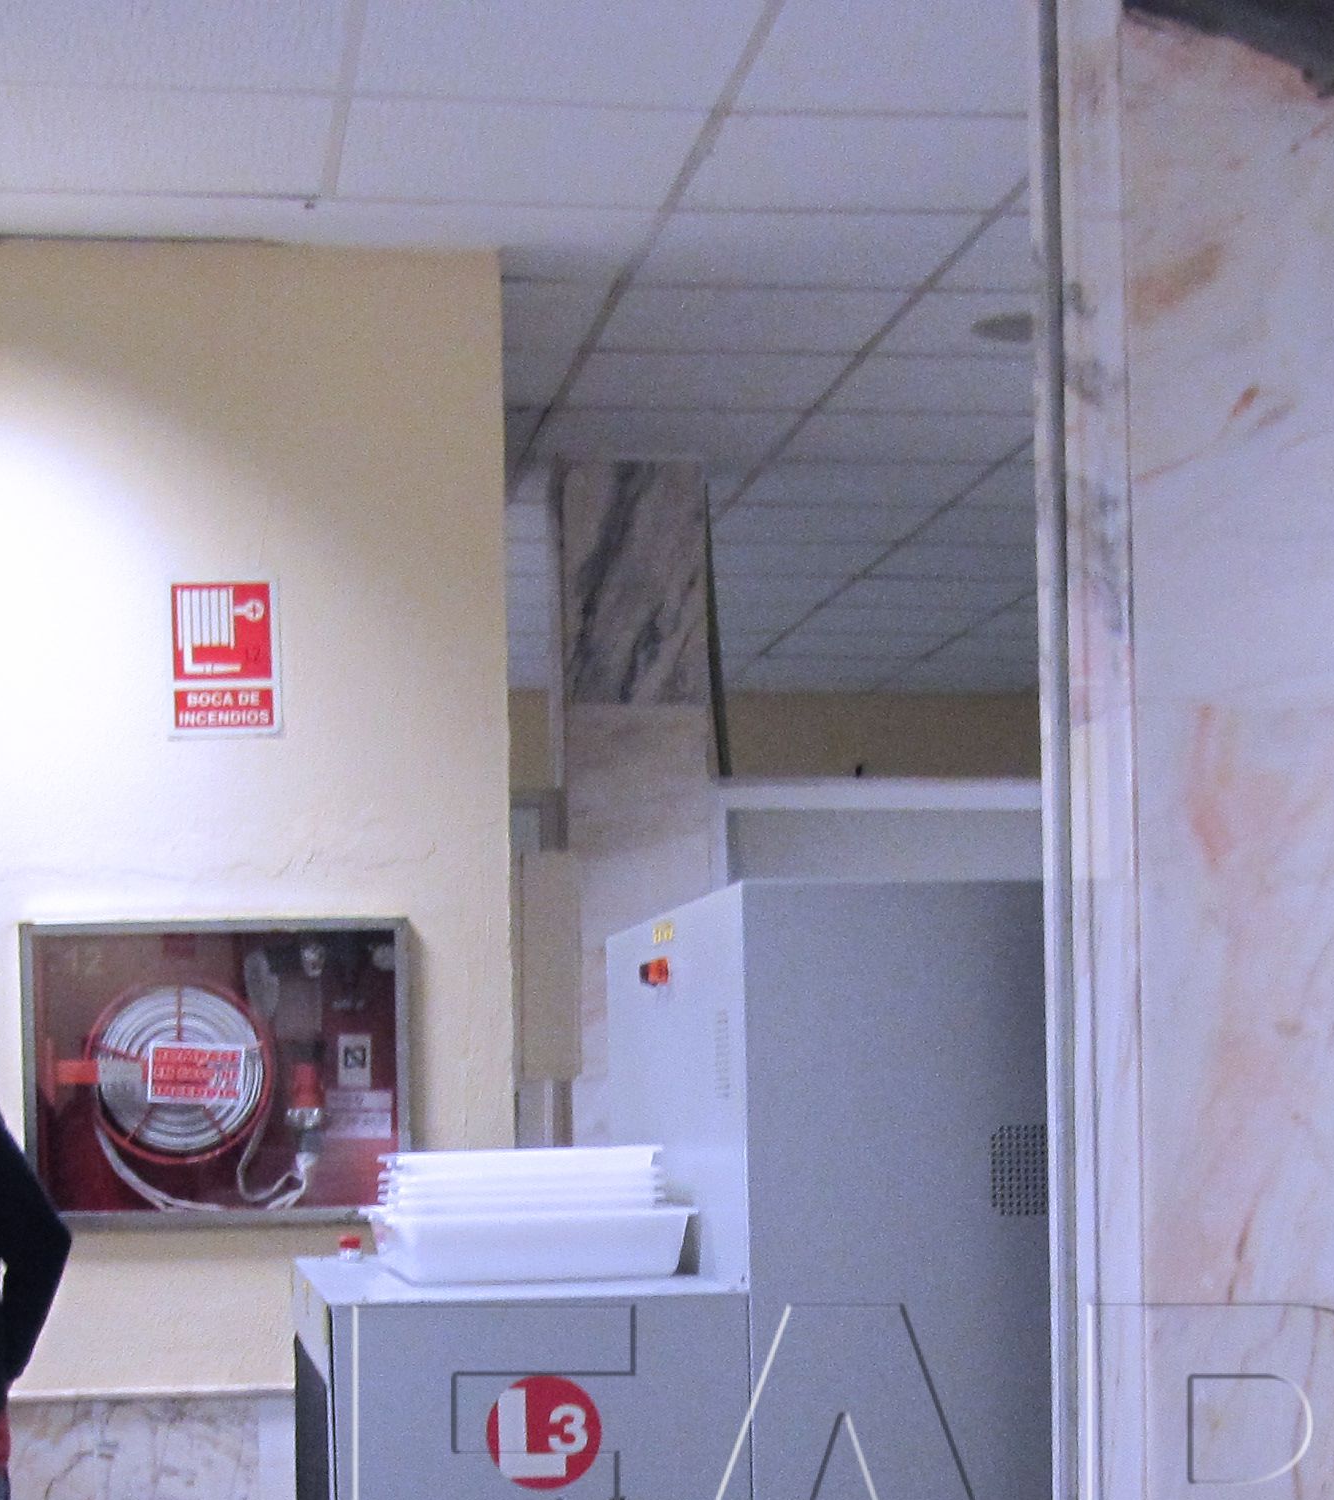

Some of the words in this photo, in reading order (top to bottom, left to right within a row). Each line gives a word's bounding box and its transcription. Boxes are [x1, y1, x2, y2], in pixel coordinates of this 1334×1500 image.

[187, 691, 233, 707] BOCA
[238, 690, 260, 705] DE
[178, 709, 270, 726] INCENDIOS
